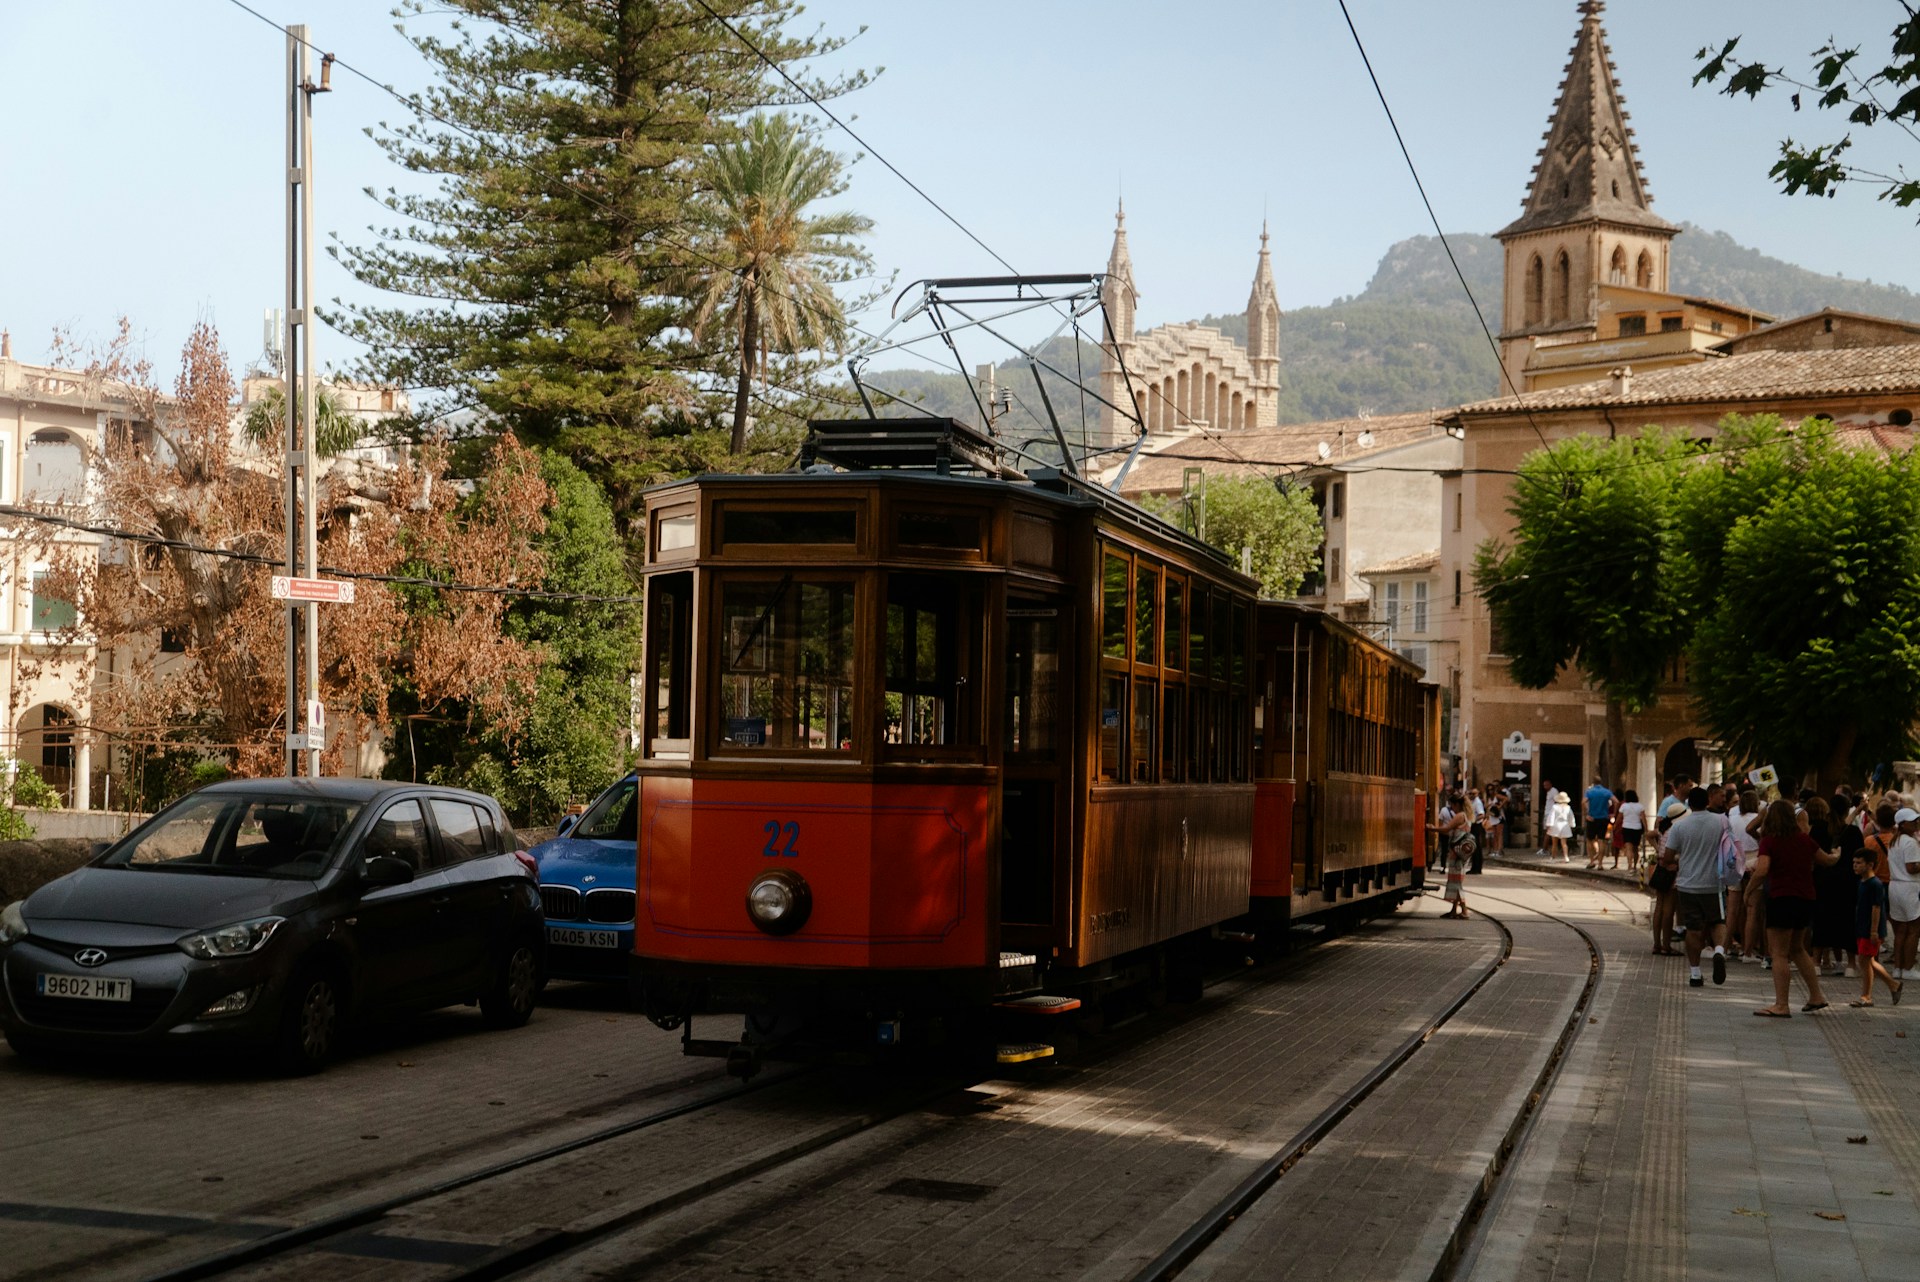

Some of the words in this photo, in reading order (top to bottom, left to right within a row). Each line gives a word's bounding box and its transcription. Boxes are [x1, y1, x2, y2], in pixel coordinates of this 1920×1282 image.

[763, 820, 799, 857] 22
[553, 929, 586, 944] 0405
[589, 932, 615, 947] KSN
[48, 976, 90, 996] 9602
[95, 980, 127, 999] HWT
